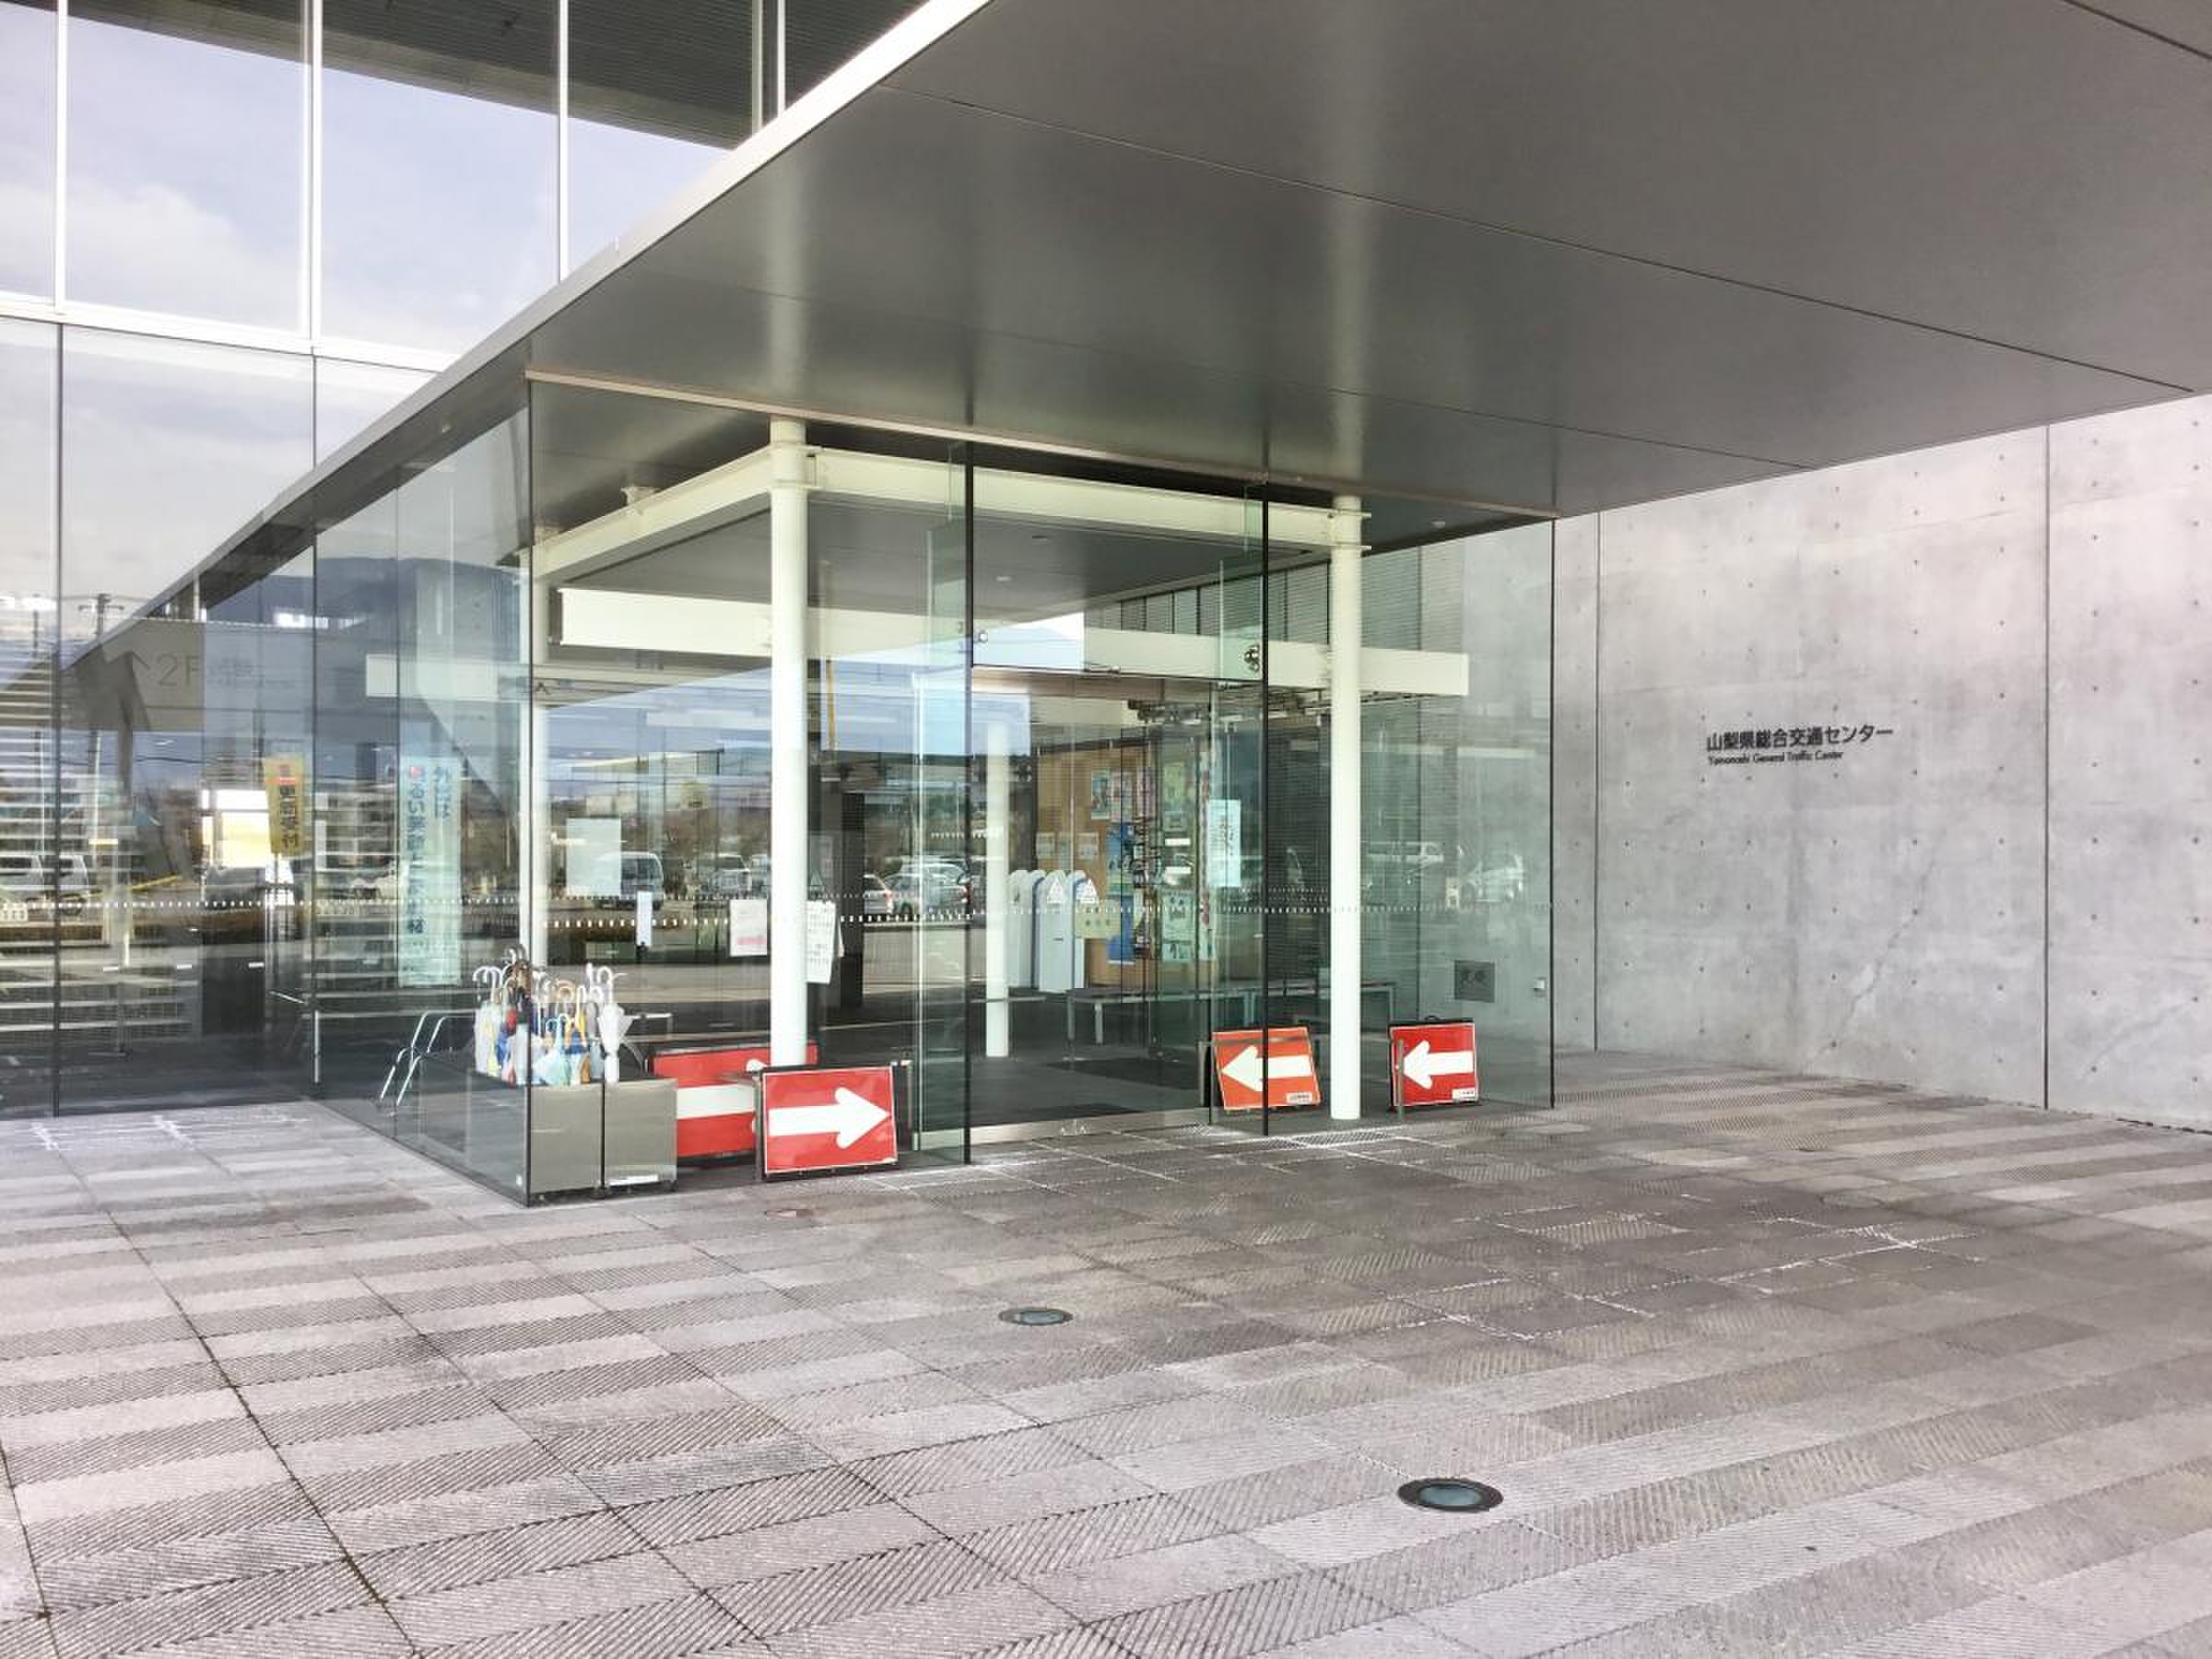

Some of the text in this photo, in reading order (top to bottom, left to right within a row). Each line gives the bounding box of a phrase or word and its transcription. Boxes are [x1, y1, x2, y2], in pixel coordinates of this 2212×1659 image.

[1707, 724, 1894, 752] 山梨県総合交通センター
[1708, 749, 1844, 766] Yamanashi General Traffic Center
